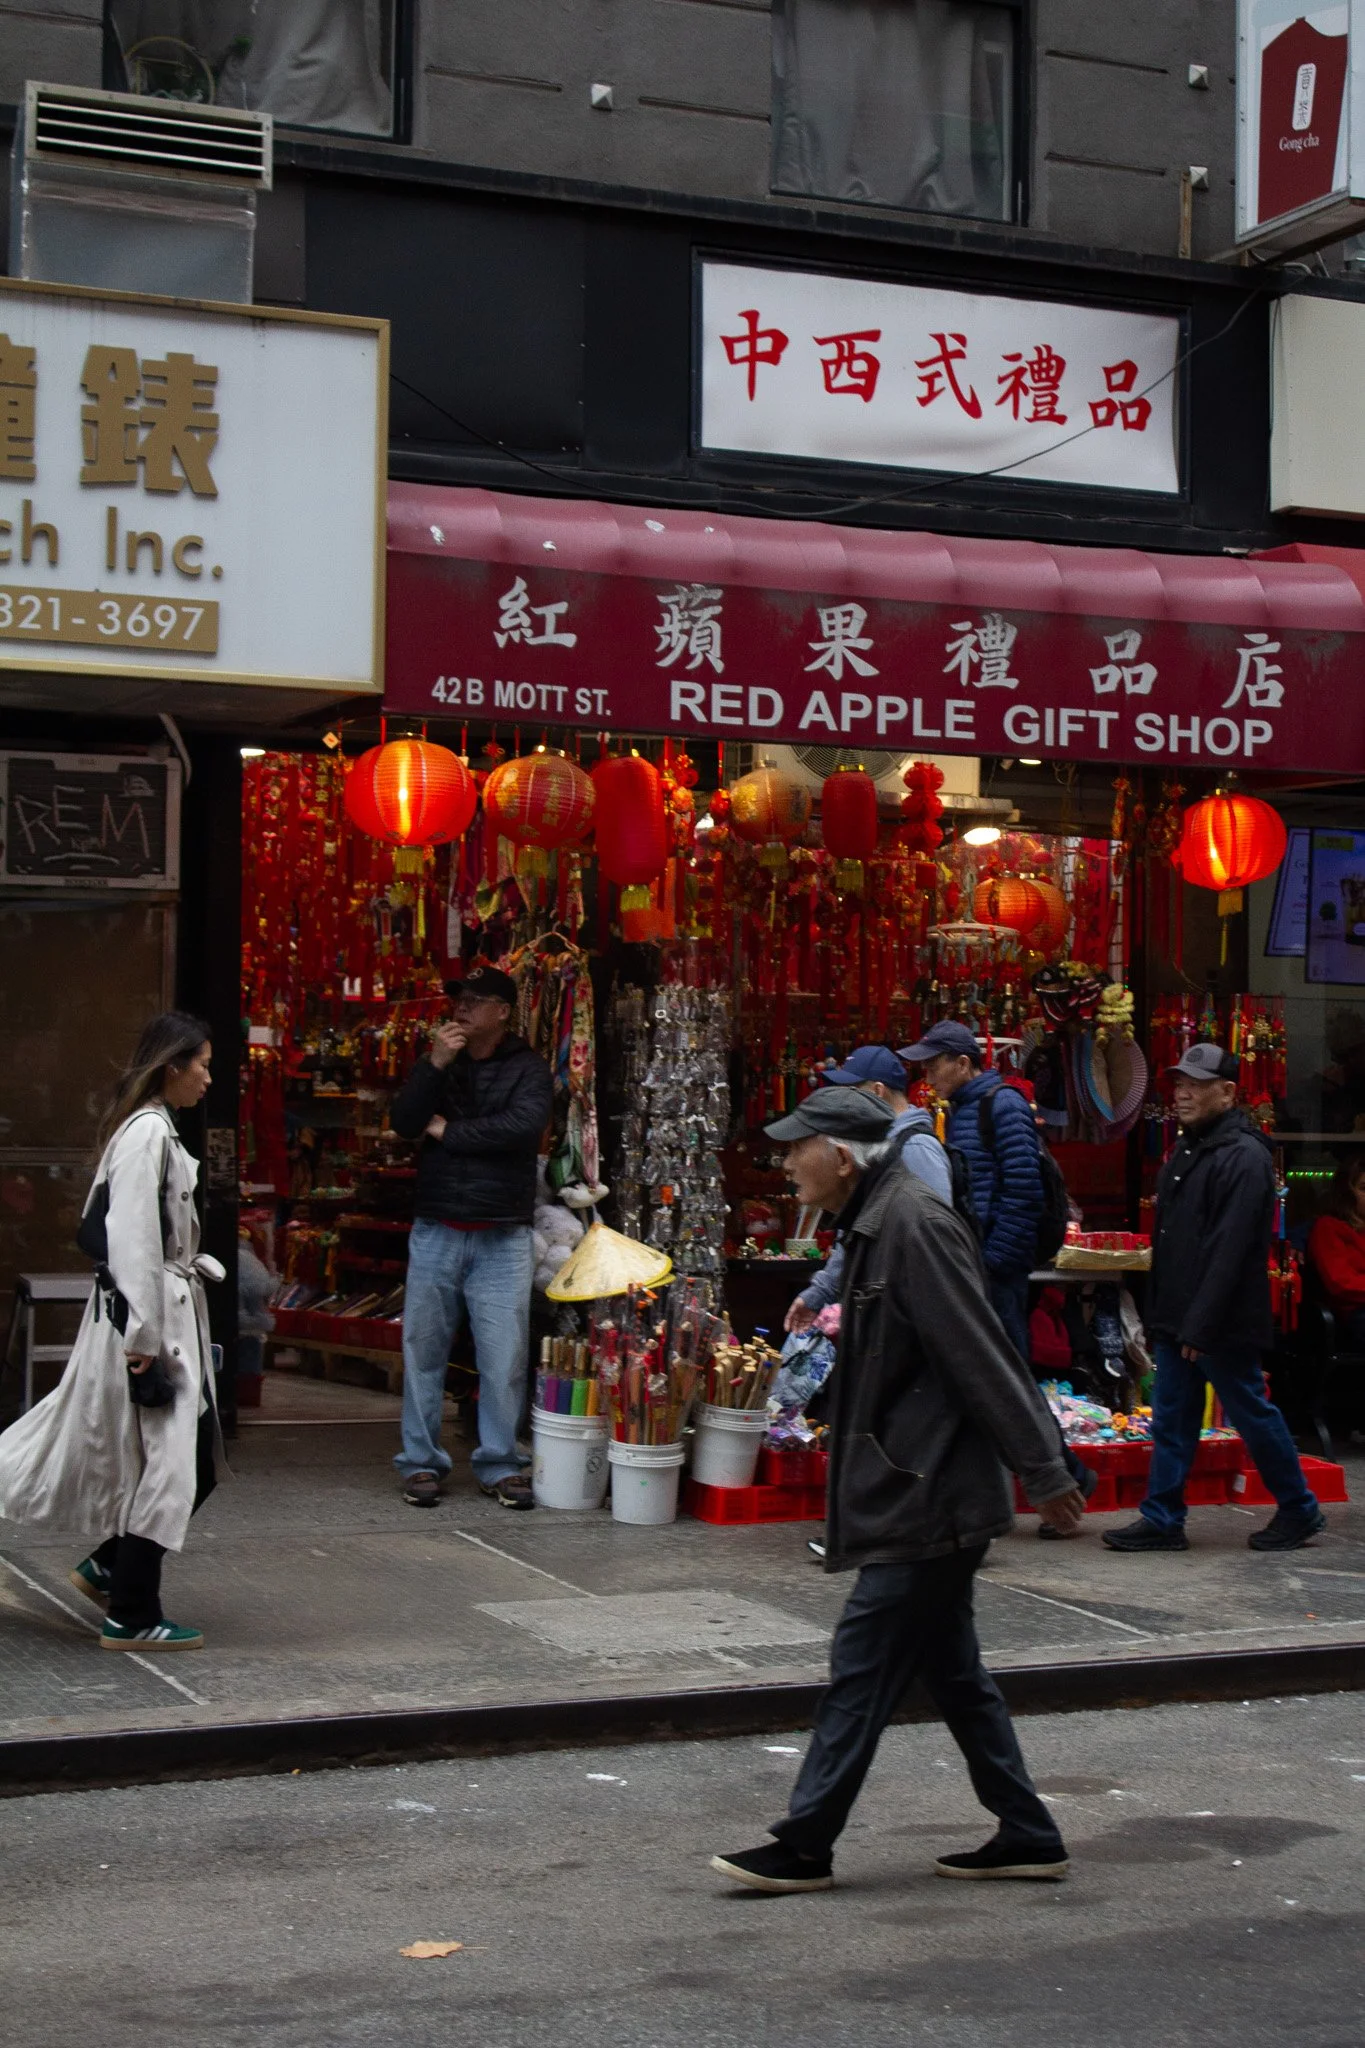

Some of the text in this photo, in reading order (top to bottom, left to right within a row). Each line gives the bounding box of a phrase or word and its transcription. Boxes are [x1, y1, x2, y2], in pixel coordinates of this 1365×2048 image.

[1279, 133, 1320, 153] Gong cha
[719, 309, 1152, 432] 中西式禮品
[0, 333, 219, 497] 錶
[107, 506, 224, 578] Inc.
[493, 575, 1285, 708] 紅蘋果禮品店
[431, 675, 612, 717] 42B MOTT ST.
[670, 680, 1274, 757] RED APPLE GIFT SHOP
[15, 784, 150, 859] REM
